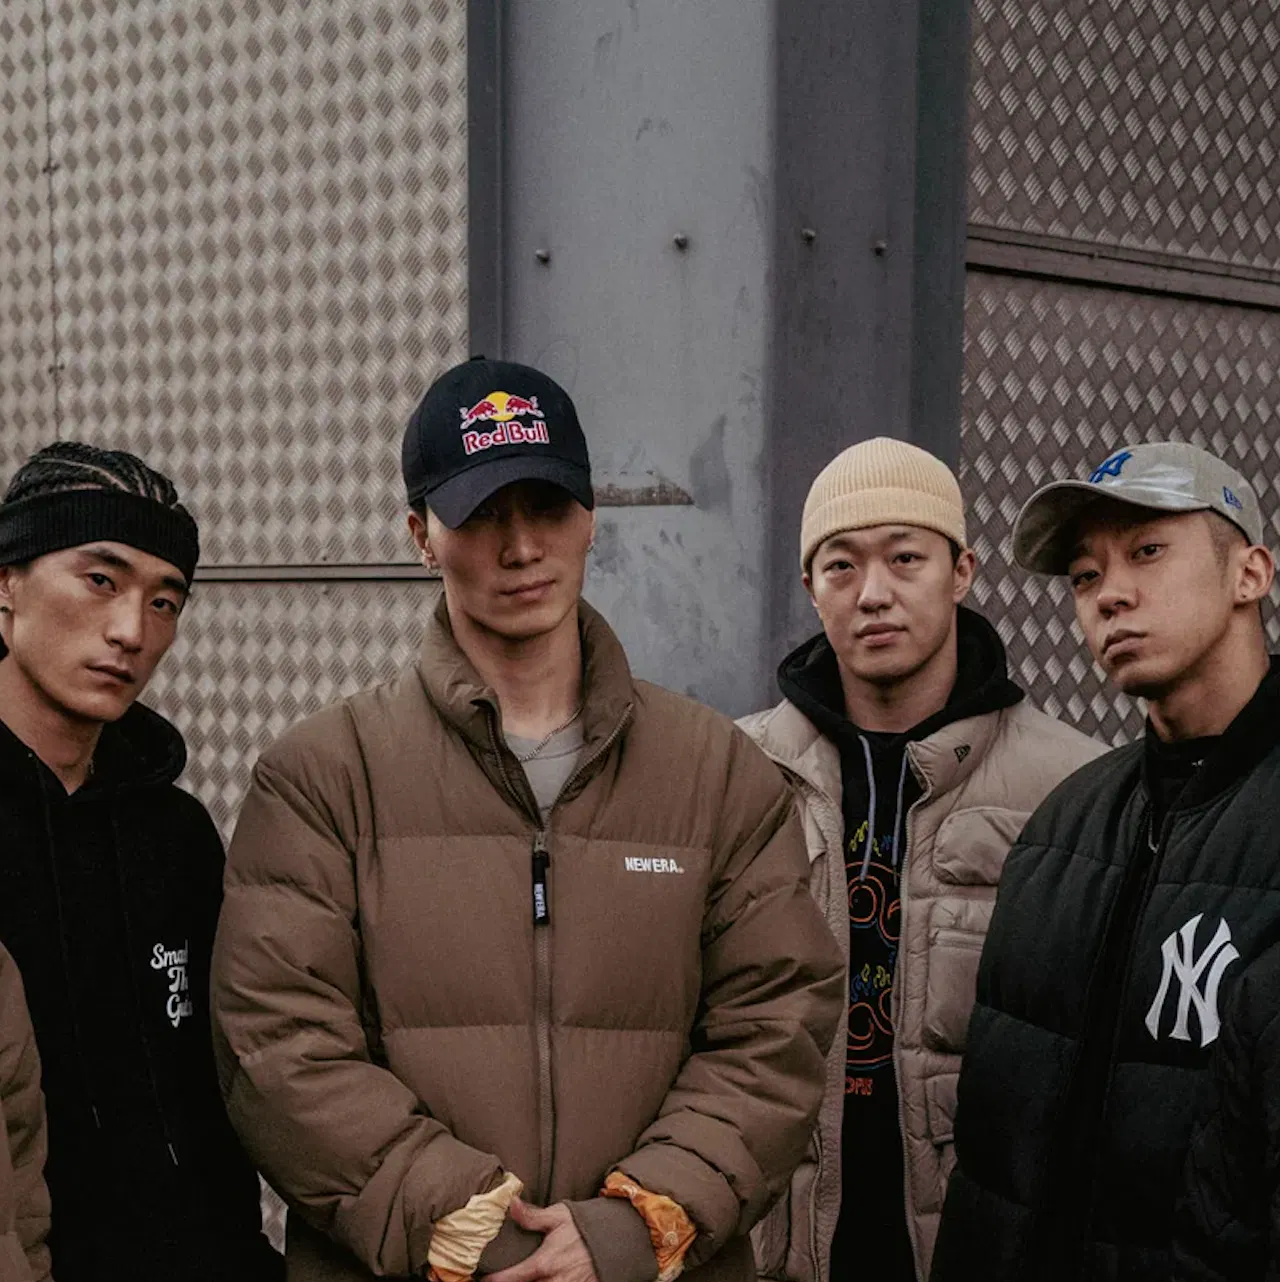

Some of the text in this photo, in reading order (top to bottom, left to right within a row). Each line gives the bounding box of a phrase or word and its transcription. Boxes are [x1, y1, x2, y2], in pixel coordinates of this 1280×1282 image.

[462, 421, 550, 455] Red Bull
[1145, 912, 1240, 1048] NY
